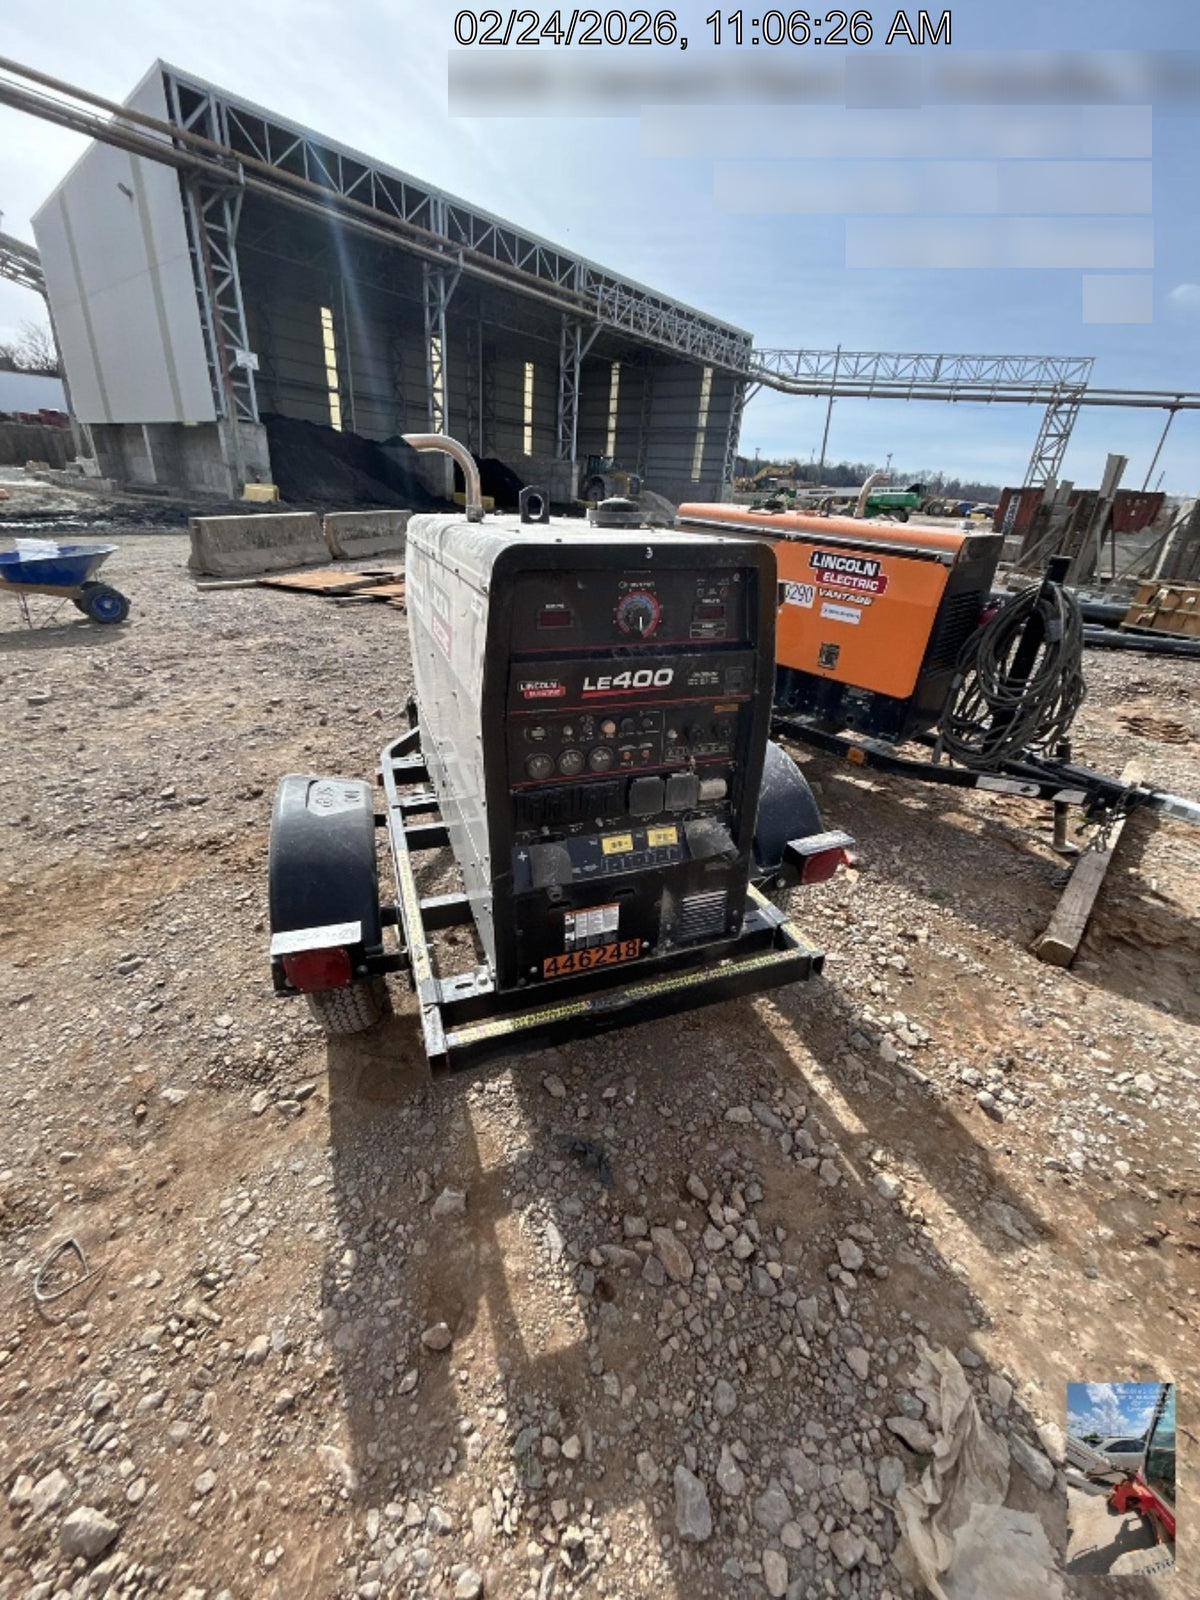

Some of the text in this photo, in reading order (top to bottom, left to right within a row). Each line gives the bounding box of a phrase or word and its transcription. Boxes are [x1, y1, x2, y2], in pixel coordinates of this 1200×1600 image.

[812, 553, 877, 576] LINCOLN
[822, 572, 879, 591] ELECTRIC
[582, 667, 675, 690] LE400
[545, 940, 638, 974] 446248
